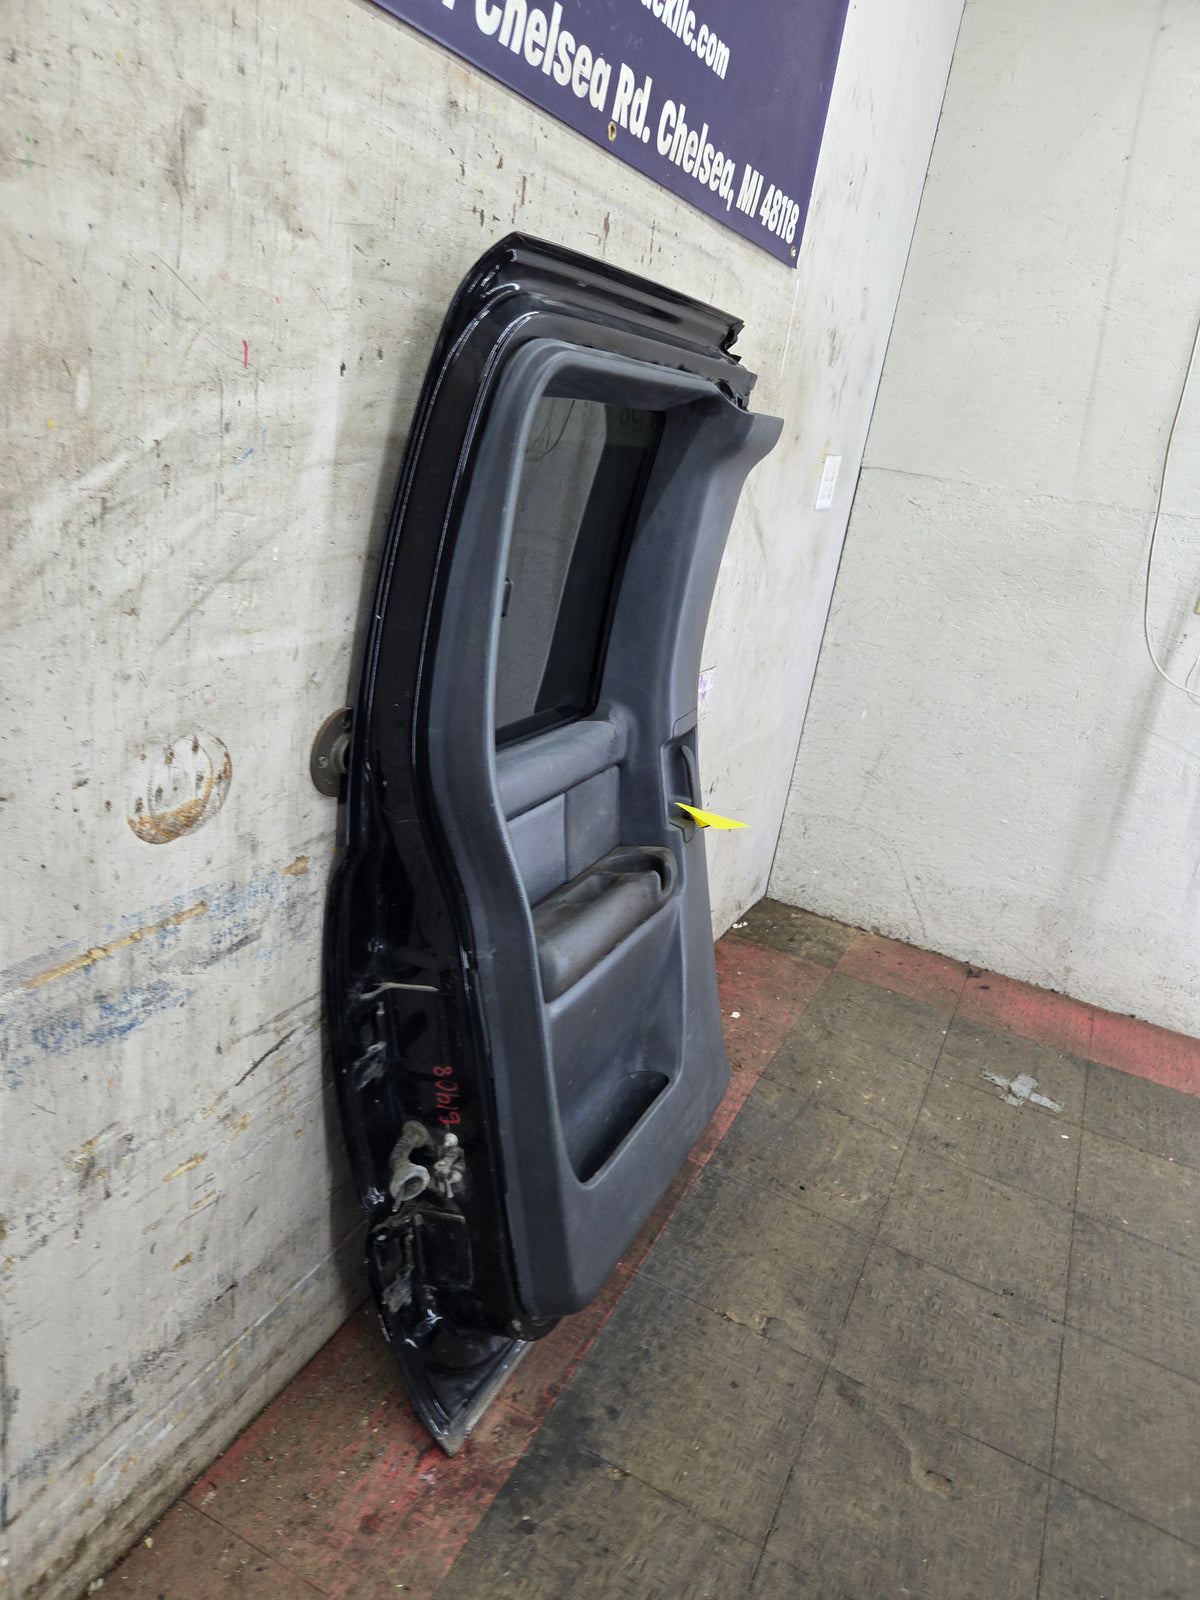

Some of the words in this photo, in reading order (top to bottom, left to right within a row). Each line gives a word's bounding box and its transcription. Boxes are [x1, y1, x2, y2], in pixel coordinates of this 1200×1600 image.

[641, 0, 731, 79] kllc.com
[612, 63, 652, 143] Rd.
[656, 100, 735, 211] Chelsea,
[736, 164, 764, 218] MI
[759, 184, 800, 244] 48118
